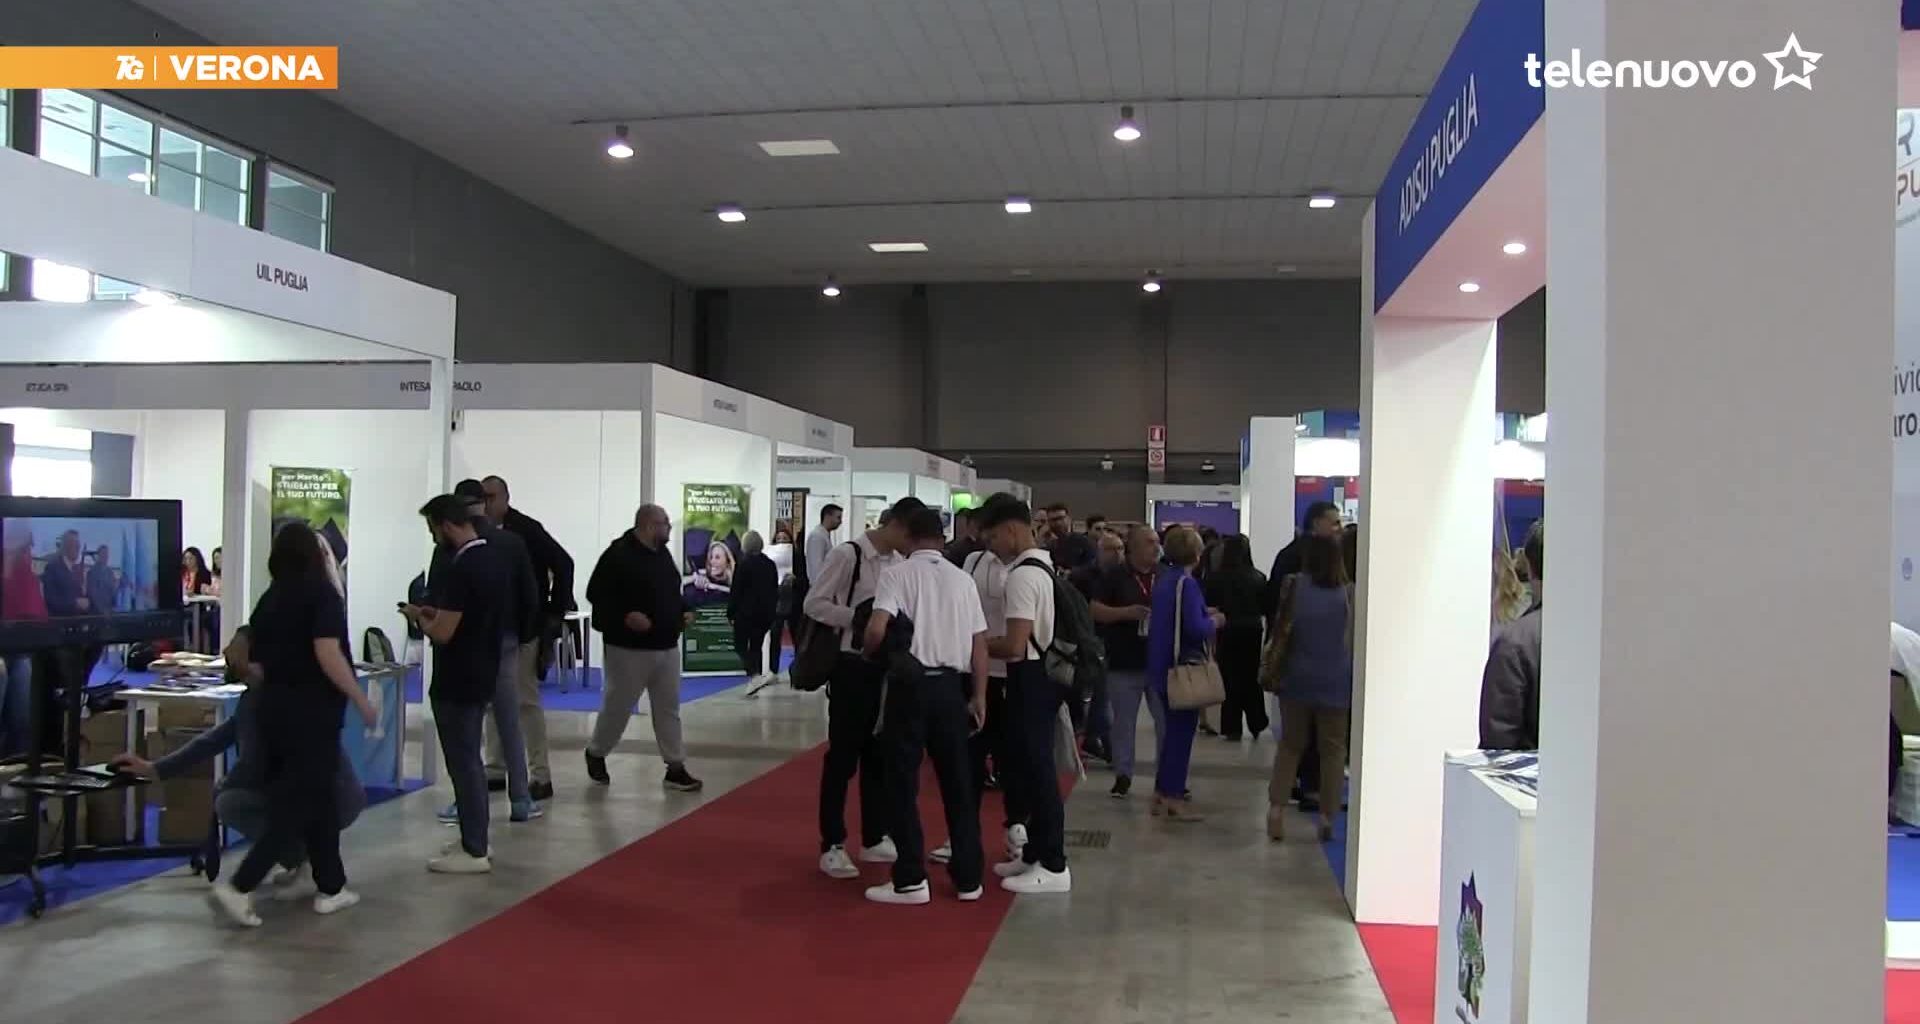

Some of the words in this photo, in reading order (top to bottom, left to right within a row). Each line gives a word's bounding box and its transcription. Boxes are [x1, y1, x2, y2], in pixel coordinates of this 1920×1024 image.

[1399, 147, 1429, 237] ADISU
[1430, 72, 1479, 192] PUGLIA
[1897, 169, 1920, 206] PU
[256, 262, 273, 282] UIL
[274, 267, 309, 292] PUGLIA
[399, 381, 431, 392] INTESA
